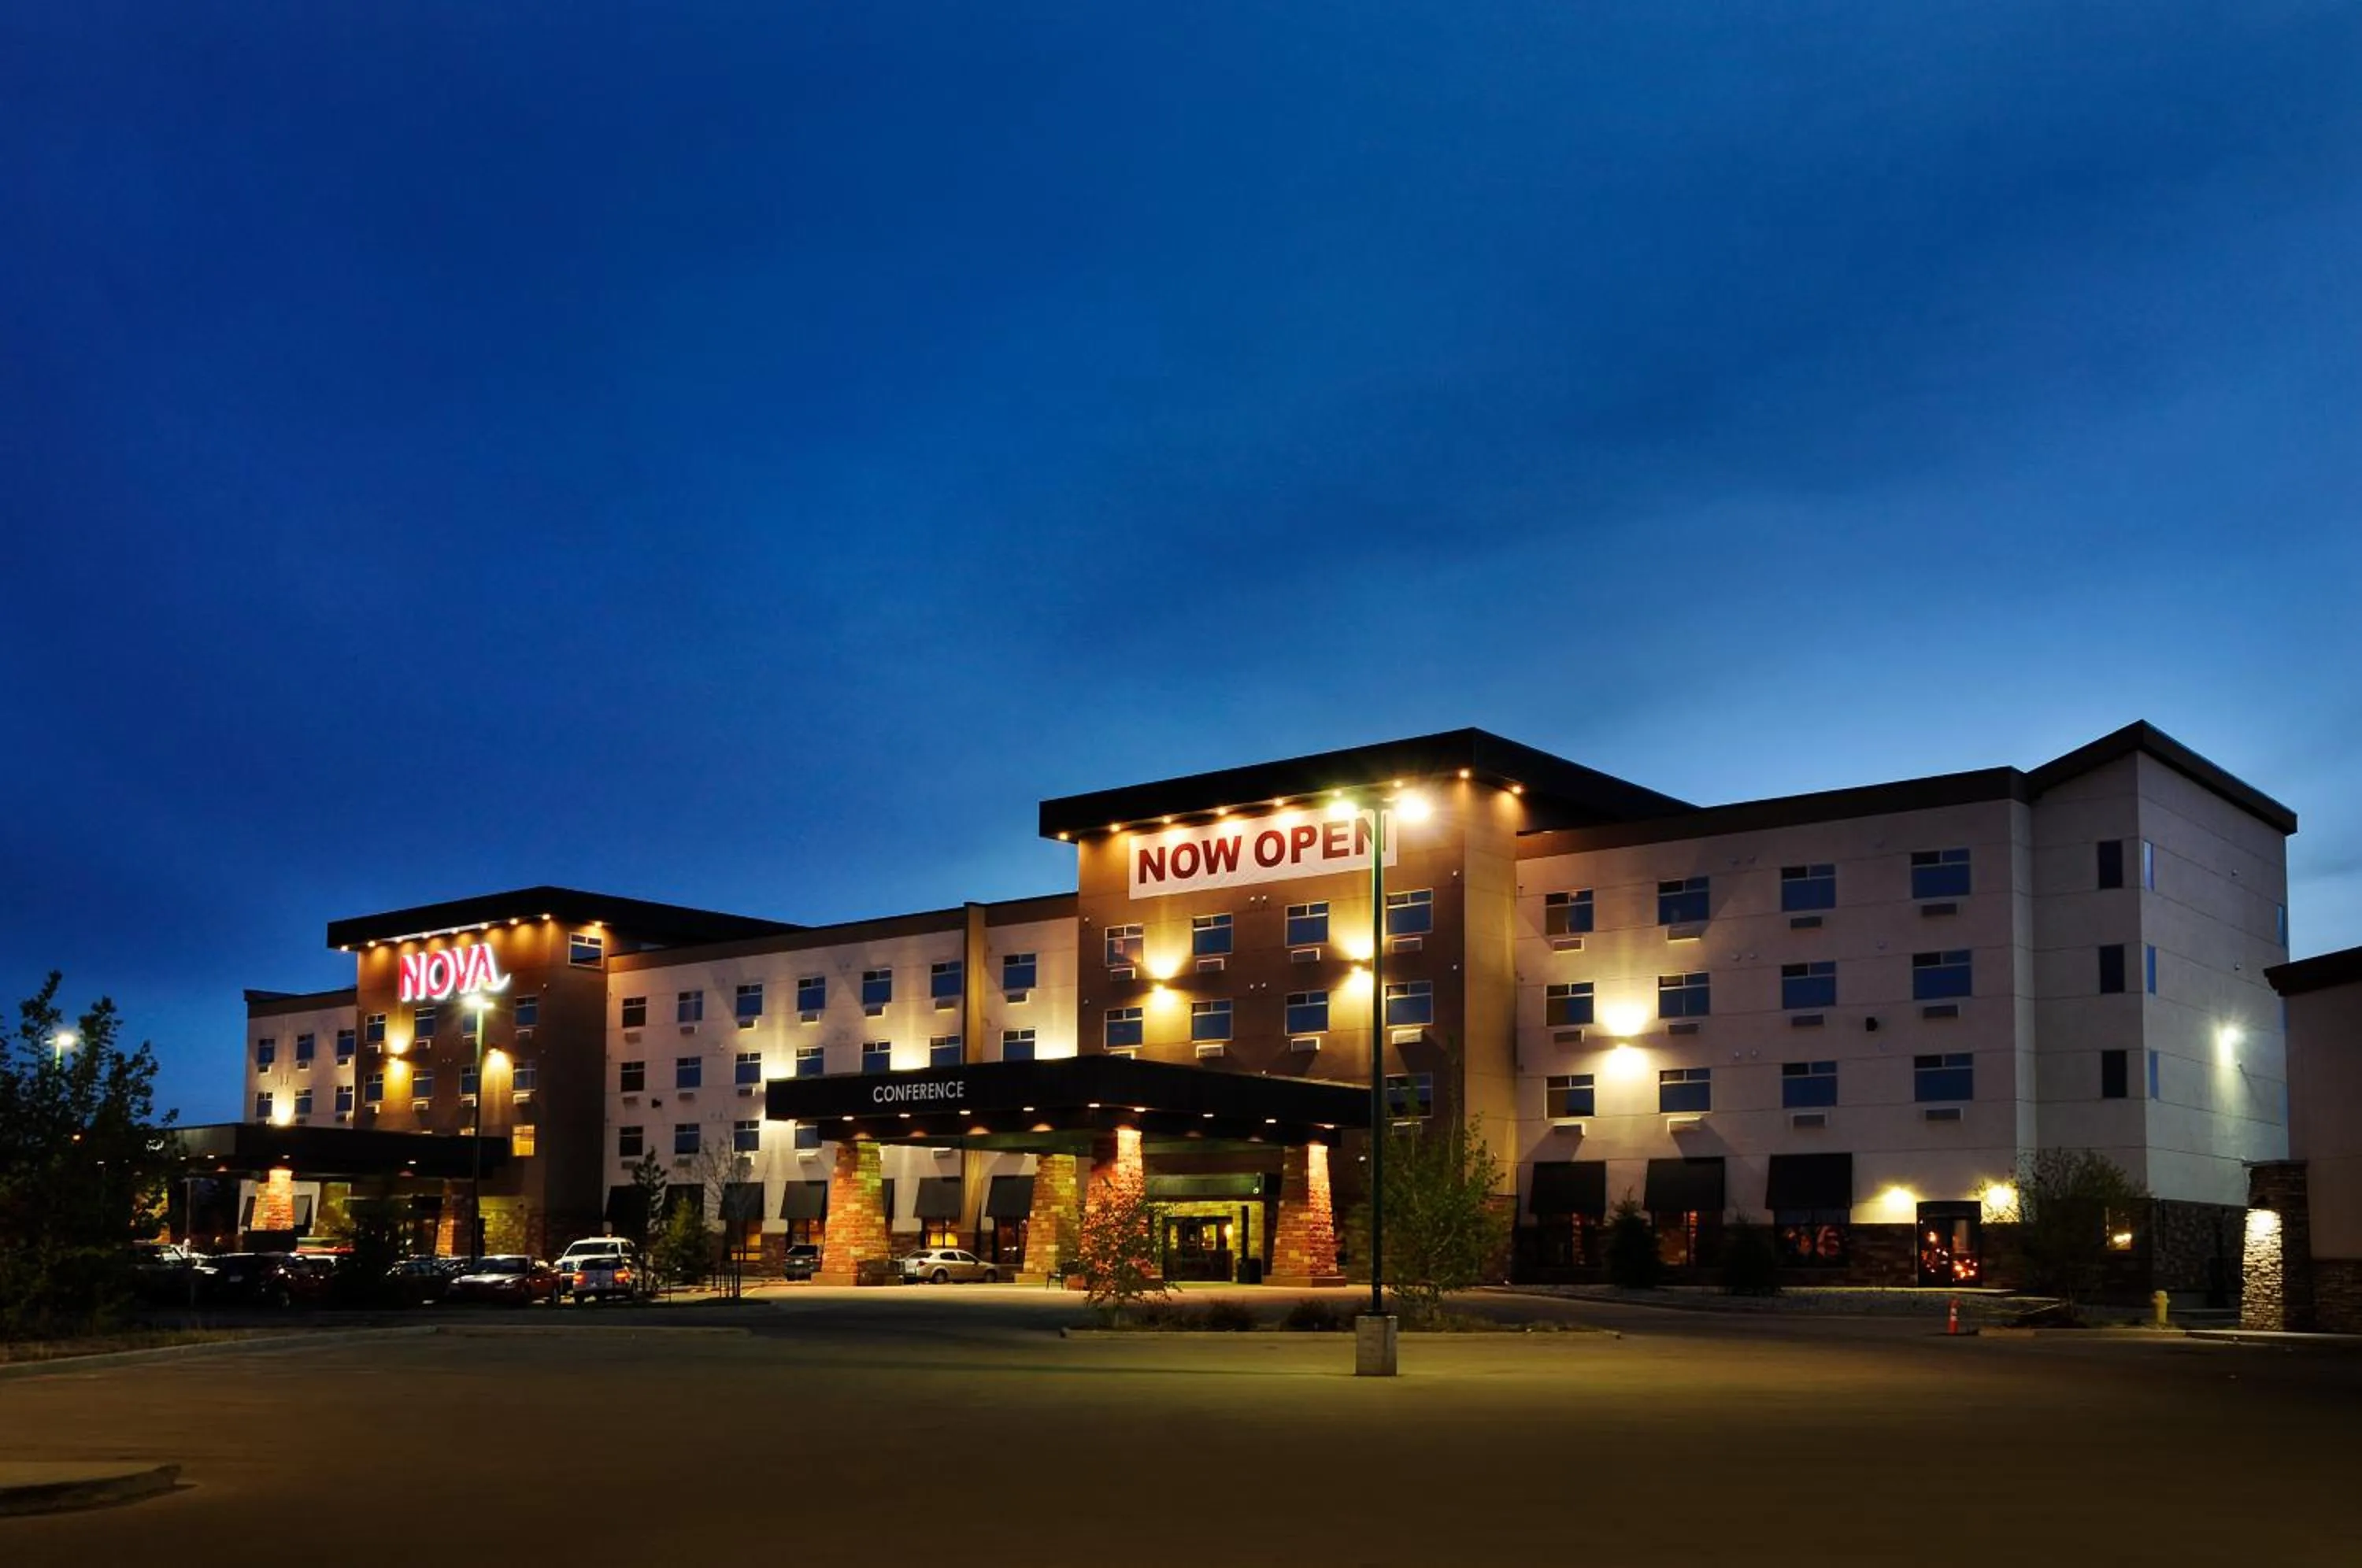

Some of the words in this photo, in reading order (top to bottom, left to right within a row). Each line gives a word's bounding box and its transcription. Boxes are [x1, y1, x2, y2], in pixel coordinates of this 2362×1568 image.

[1138, 835, 1242, 884] NOW
[1254, 812, 1386, 867] OPEN
[399, 942, 511, 1002] NOVA
[873, 1081, 964, 1103] CONFERENCE
